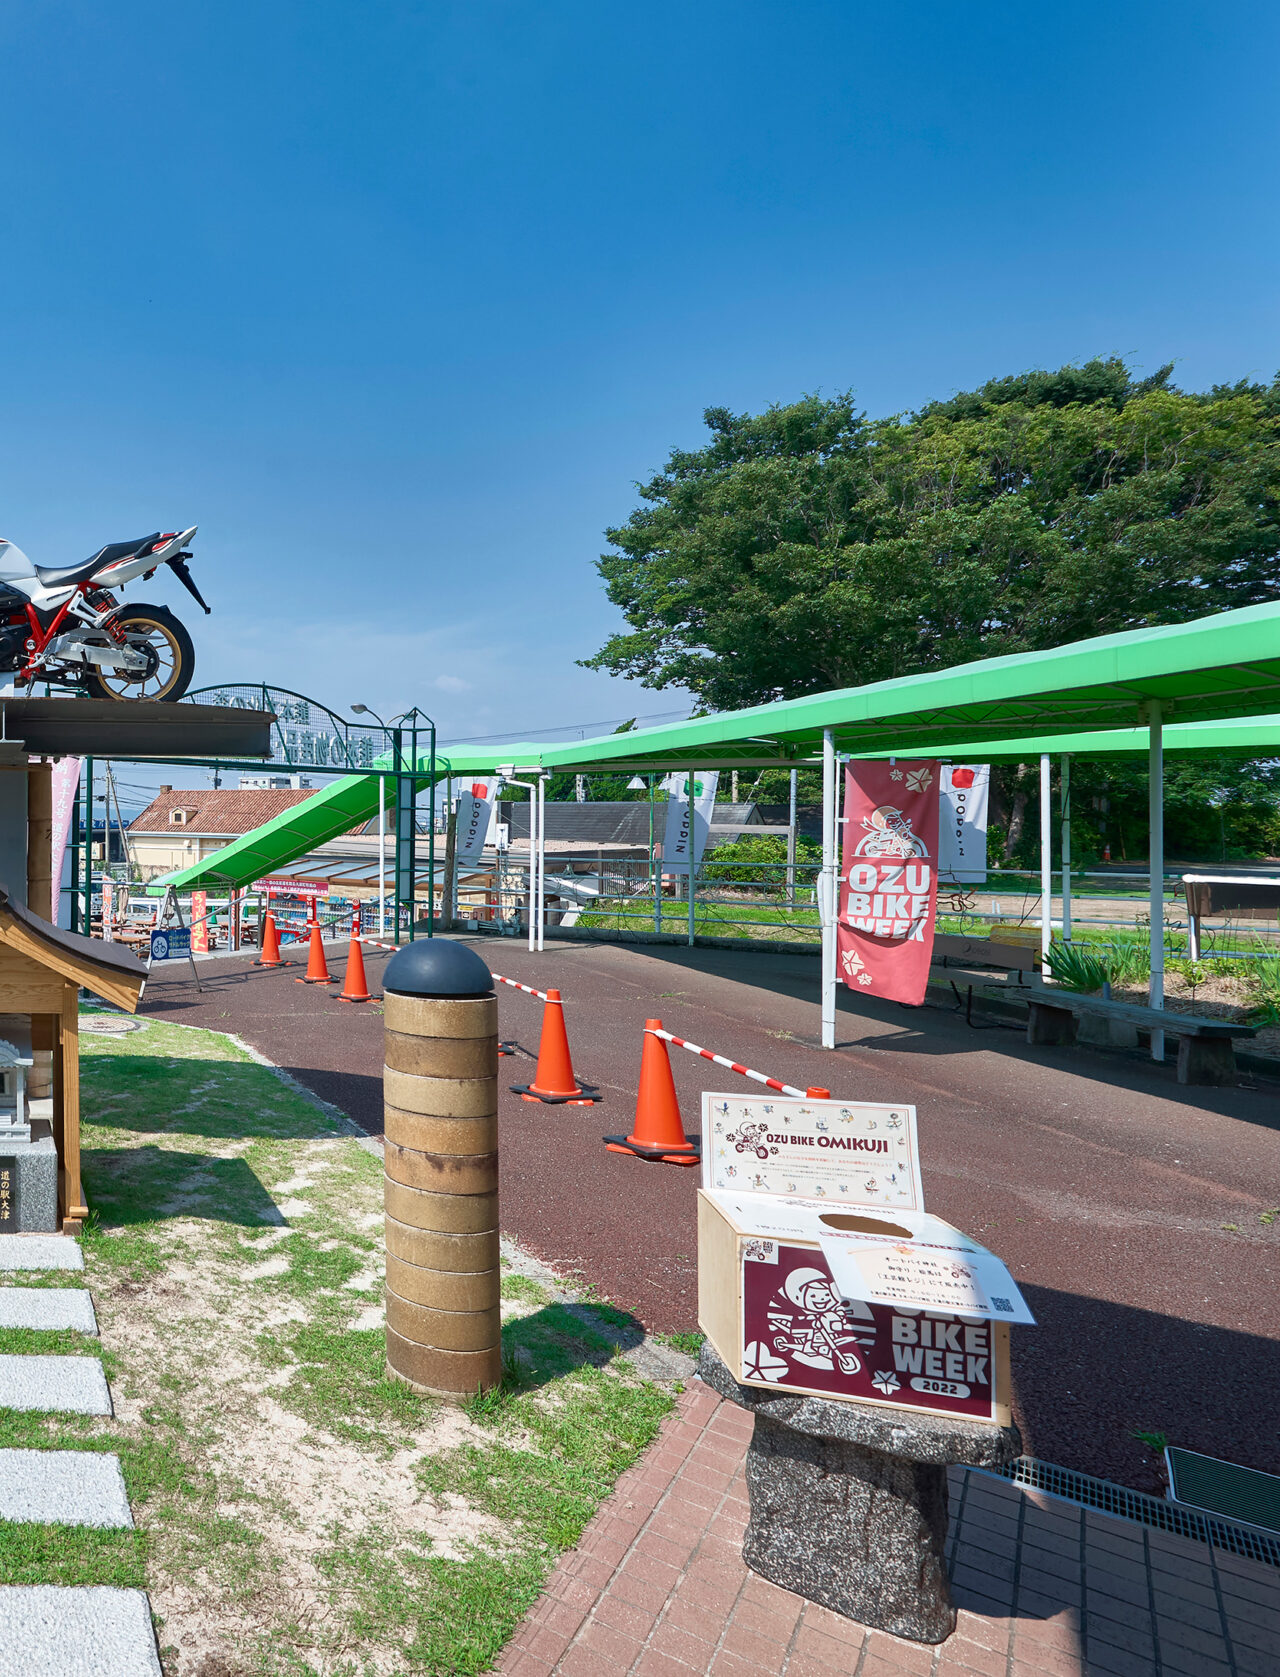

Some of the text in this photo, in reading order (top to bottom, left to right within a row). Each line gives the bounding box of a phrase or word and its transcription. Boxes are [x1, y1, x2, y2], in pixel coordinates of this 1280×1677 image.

[465, 802, 481, 849] POPPIN
[848, 863, 931, 894] OZU
[847, 893, 931, 918] BIKE
[846, 916, 928, 942] WEEK
[766, 1133, 889, 1154] OZU BIKE OMIKUJI
[0, 1170, 11, 1221] 道の駅大津
[892, 1314, 989, 1356] BIKE
[893, 1344, 990, 1385] WEEK
[922, 1380, 958, 1395] 2022
